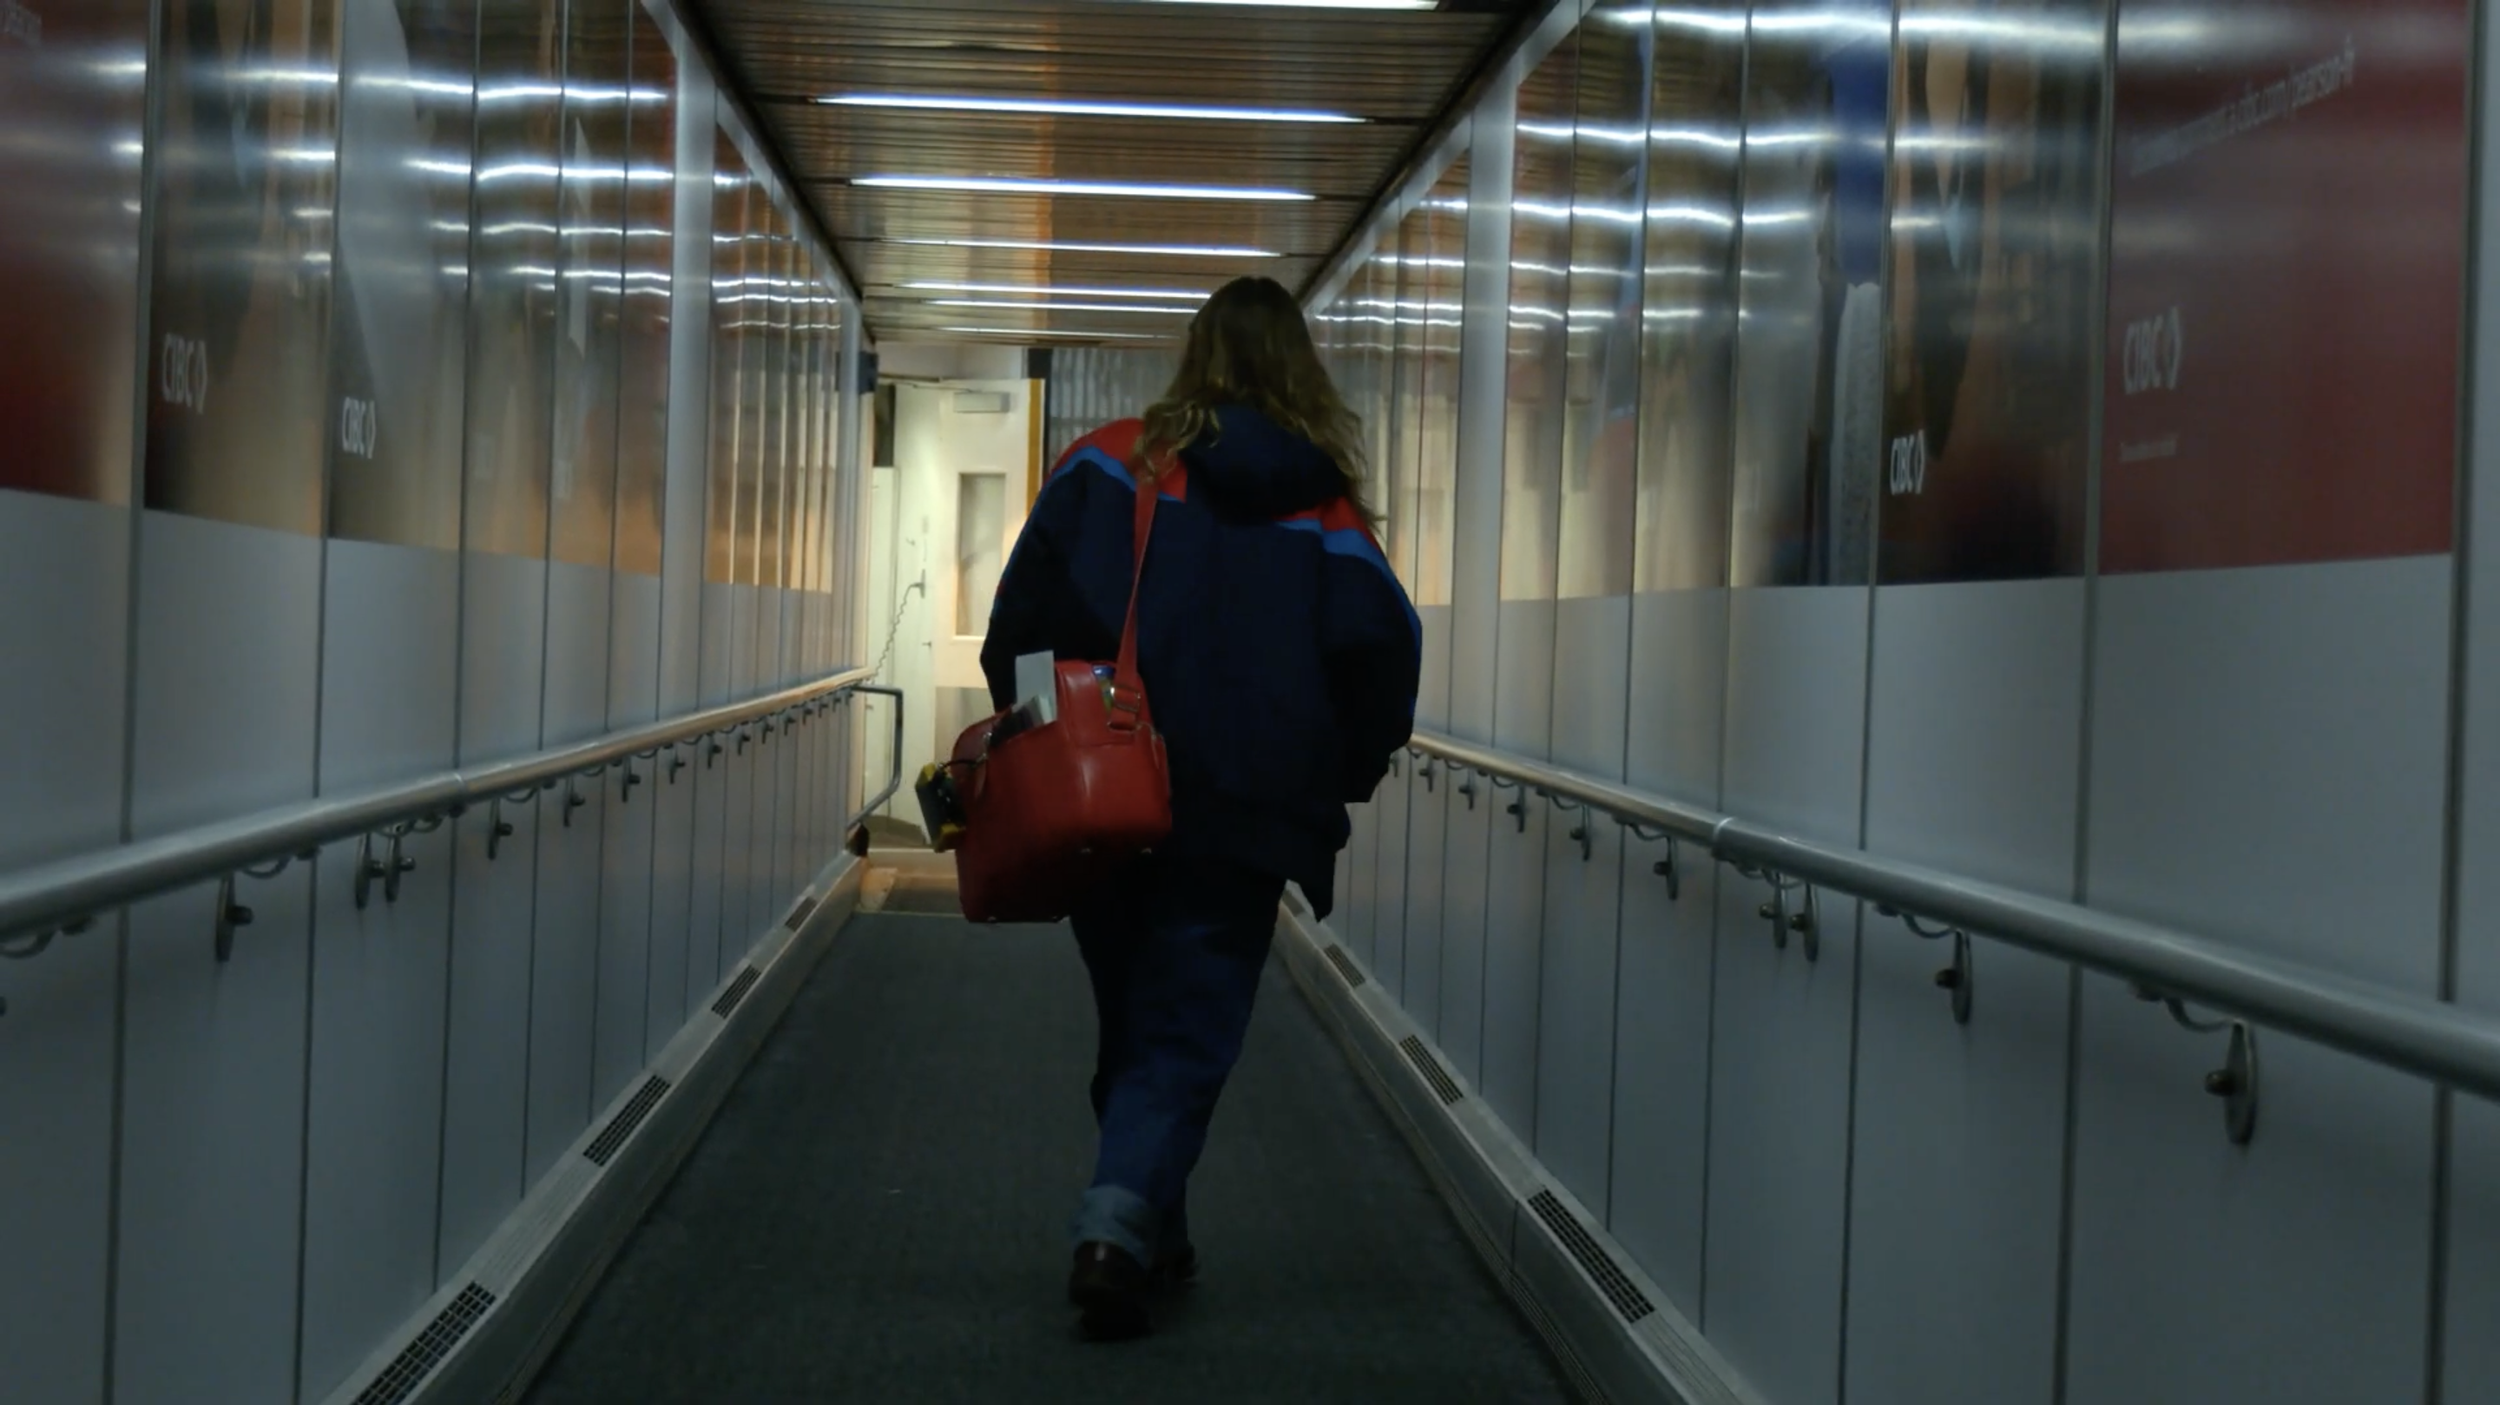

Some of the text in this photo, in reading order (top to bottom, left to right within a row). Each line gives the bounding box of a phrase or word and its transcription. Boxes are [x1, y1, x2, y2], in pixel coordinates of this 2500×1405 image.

[162, 331, 195, 408] CIBC
[2123, 312, 2163, 395] CIBC
[342, 396, 367, 456] CIBC
[1890, 434, 1915, 496] CIBC
